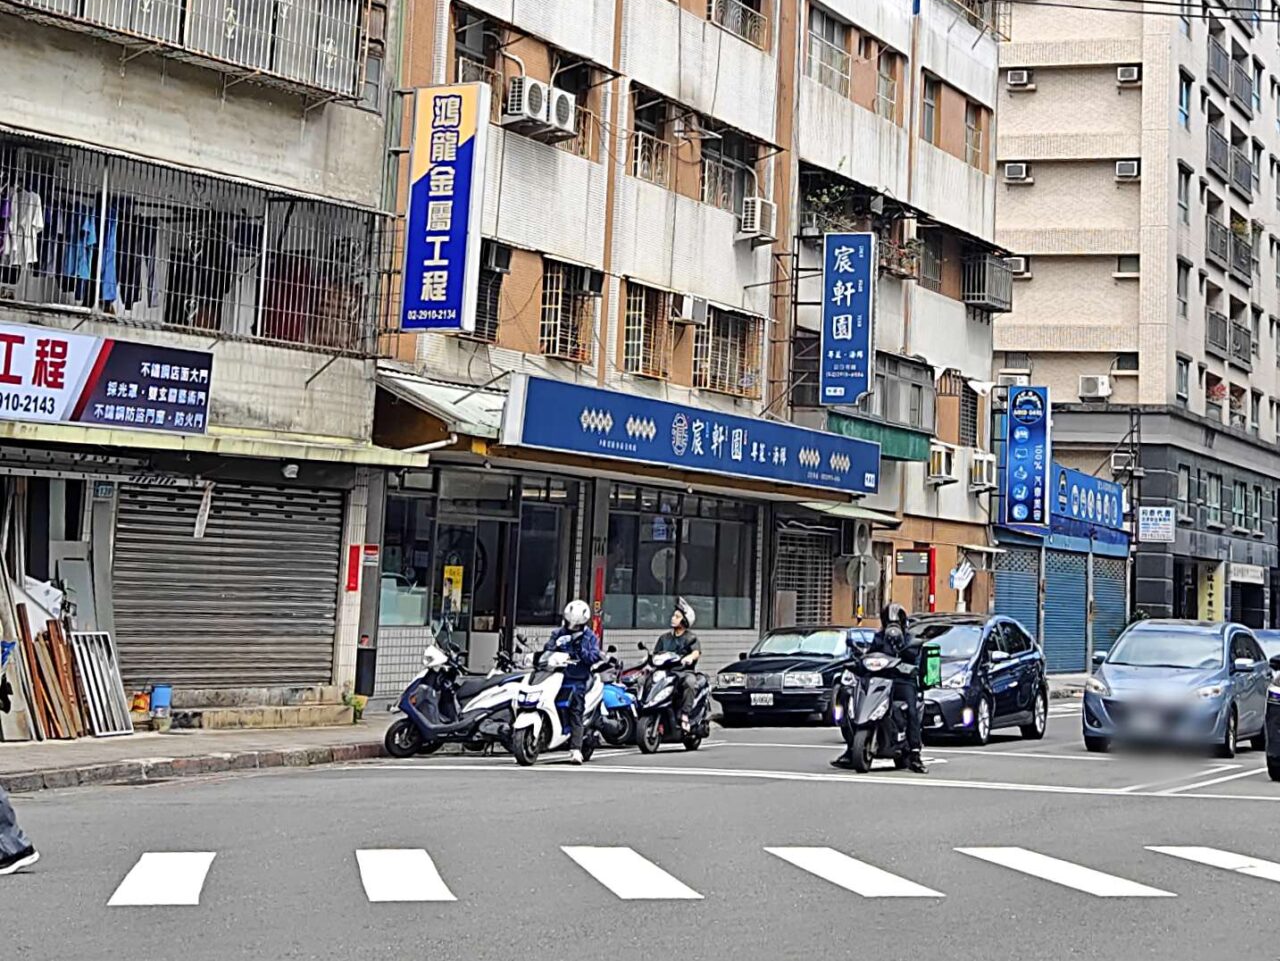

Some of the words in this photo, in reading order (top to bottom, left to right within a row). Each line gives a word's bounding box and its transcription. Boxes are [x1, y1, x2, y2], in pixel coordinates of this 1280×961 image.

[419, 94, 463, 303] 鴻龍金屬工程
[0, 332, 69, 389] 工程
